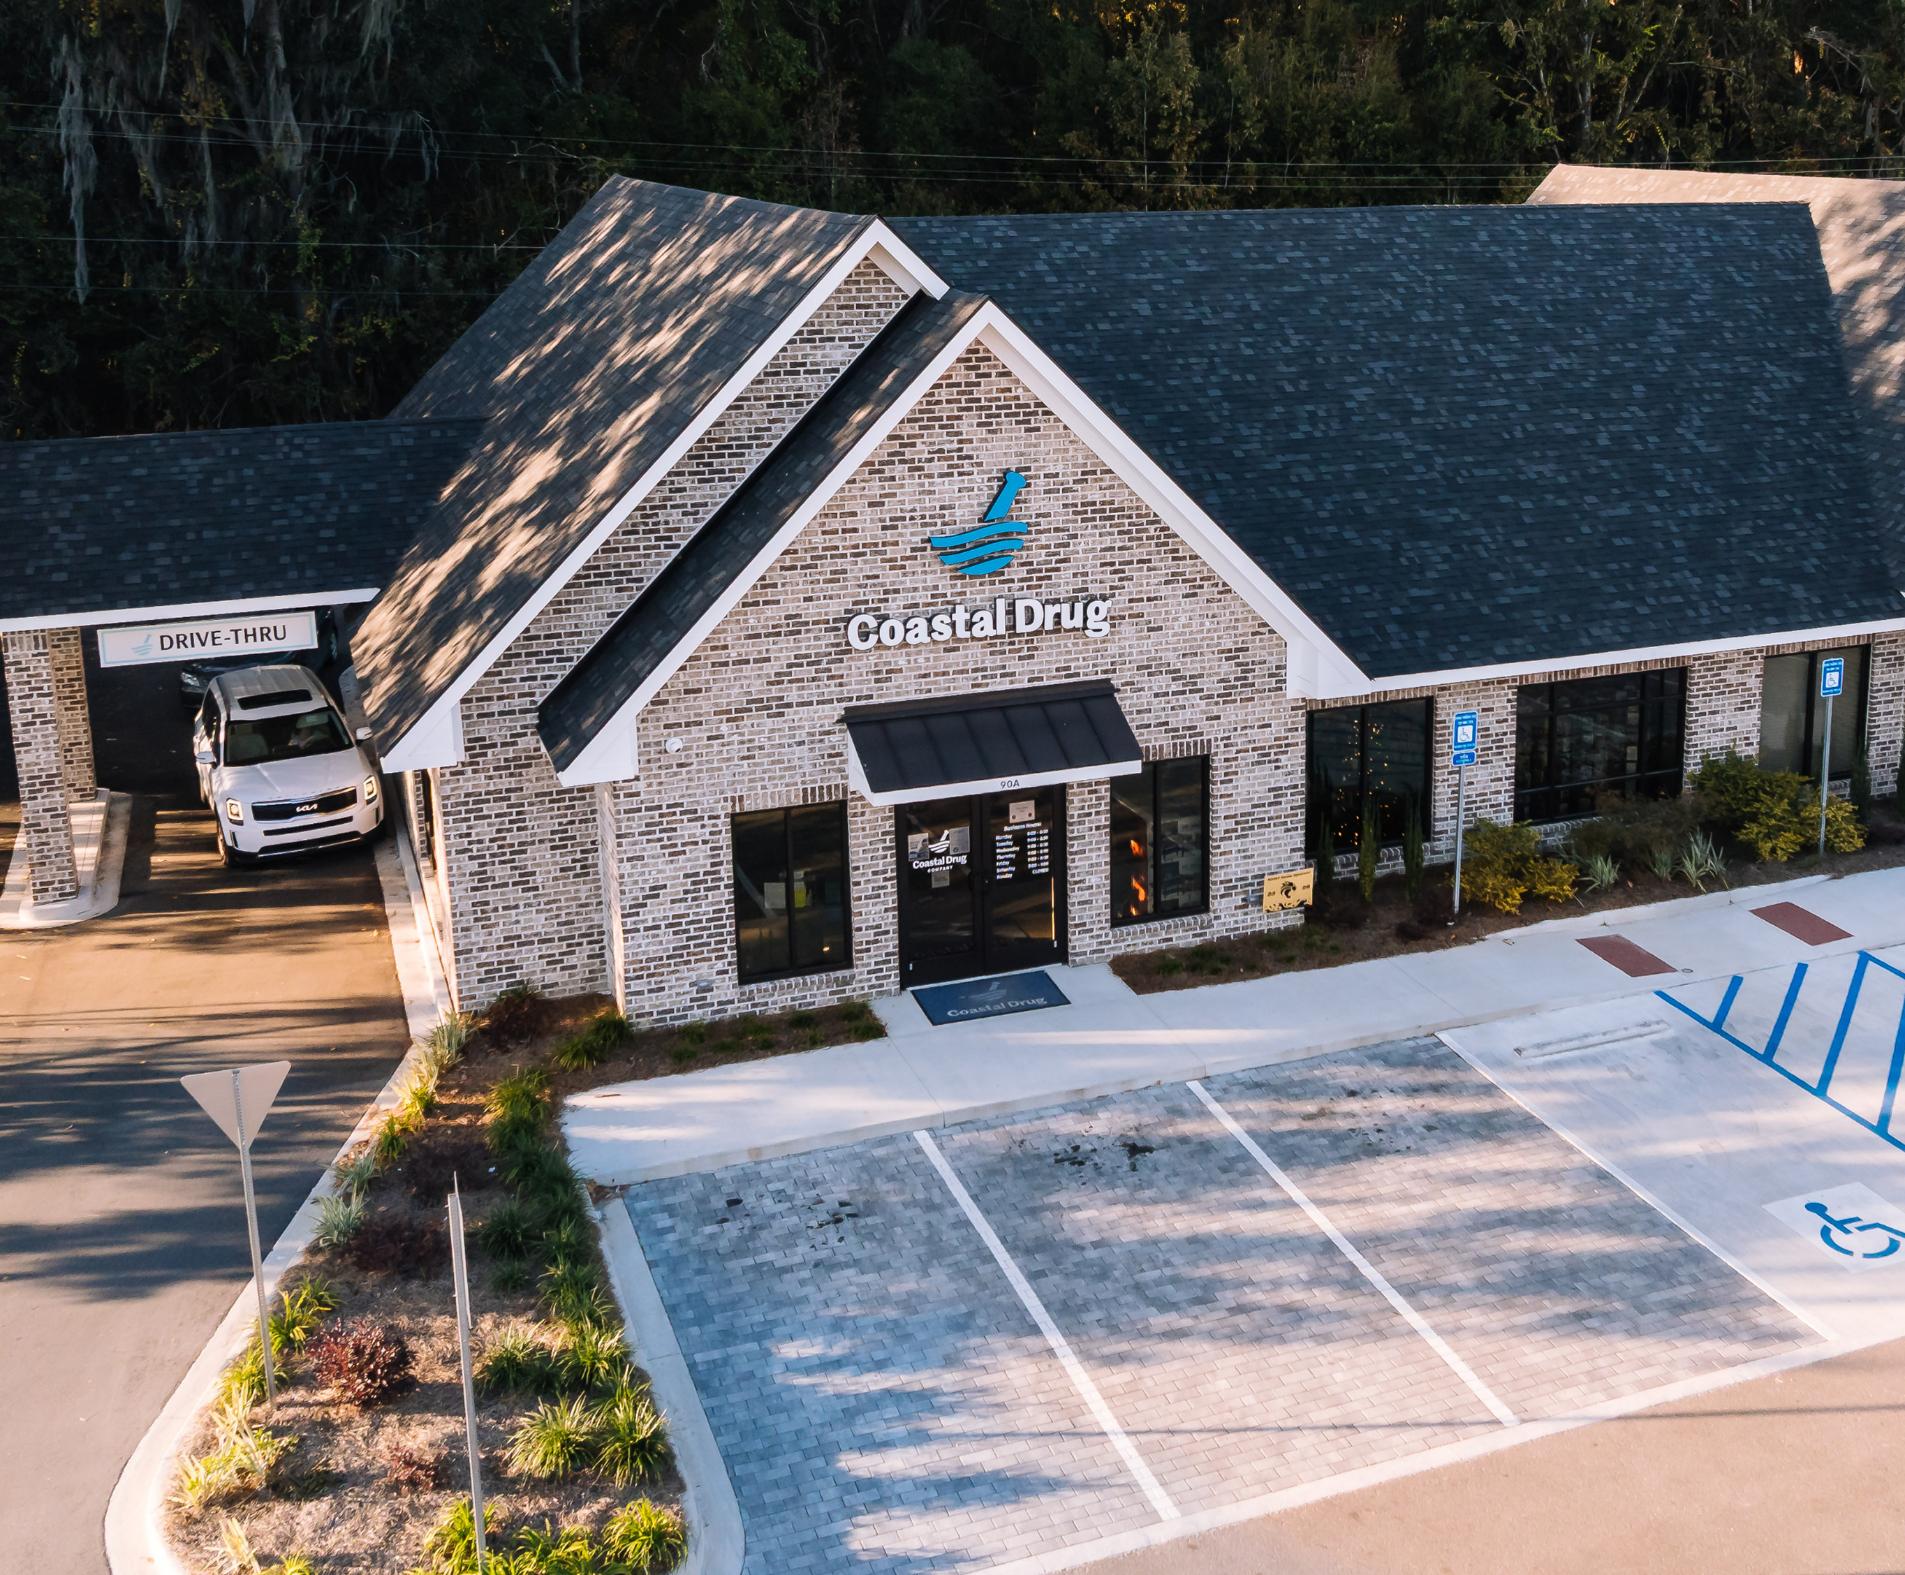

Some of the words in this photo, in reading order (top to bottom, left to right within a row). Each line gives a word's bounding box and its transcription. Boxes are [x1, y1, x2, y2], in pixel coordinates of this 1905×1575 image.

[847, 598, 1006, 650] Coastal
[1015, 599, 1112, 638] Drug
[159, 624, 287, 651] DRIVE-THRU
[1000, 779, 1020, 789] 90A
[912, 855, 945, 870] Coastal
[946, 855, 967, 864] Drug
[947, 1002, 1006, 1017] Coastal
[1008, 997, 1048, 1008] Drug
